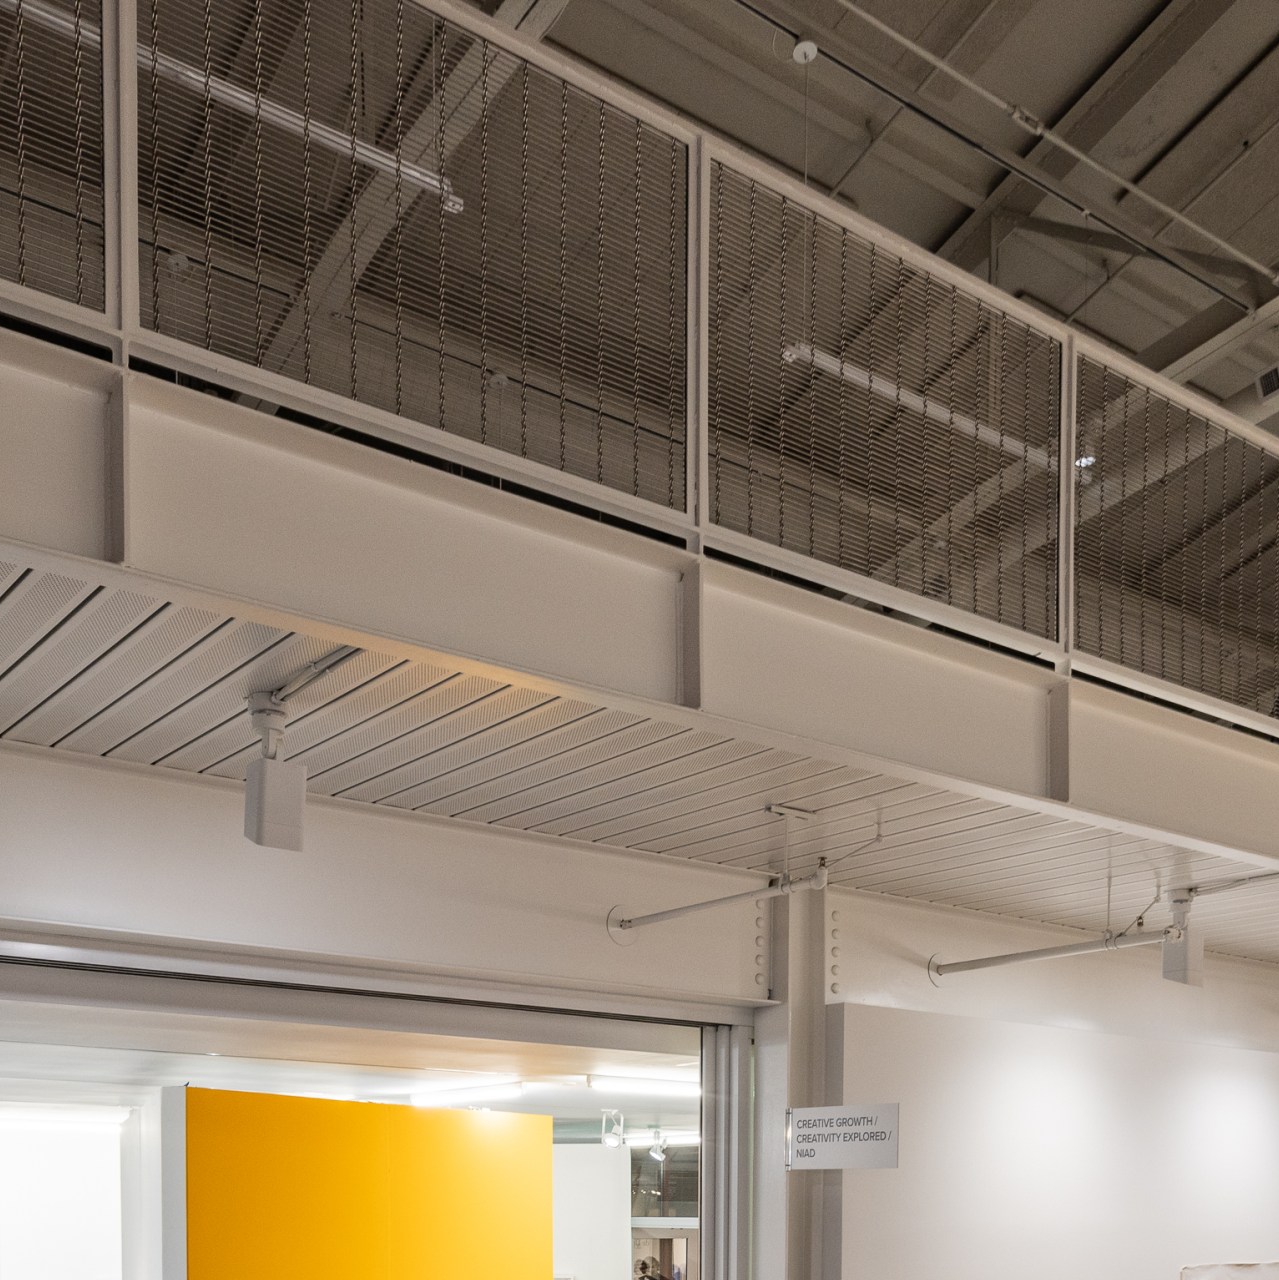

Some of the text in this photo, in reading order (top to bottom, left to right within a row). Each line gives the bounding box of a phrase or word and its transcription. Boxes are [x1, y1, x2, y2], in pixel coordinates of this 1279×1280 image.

[796, 1115, 879, 1129] CREATIVE GROWTH /
[796, 1130, 892, 1144] CREATIVITY EXPLORED /
[796, 1148, 816, 1158] NIAD
